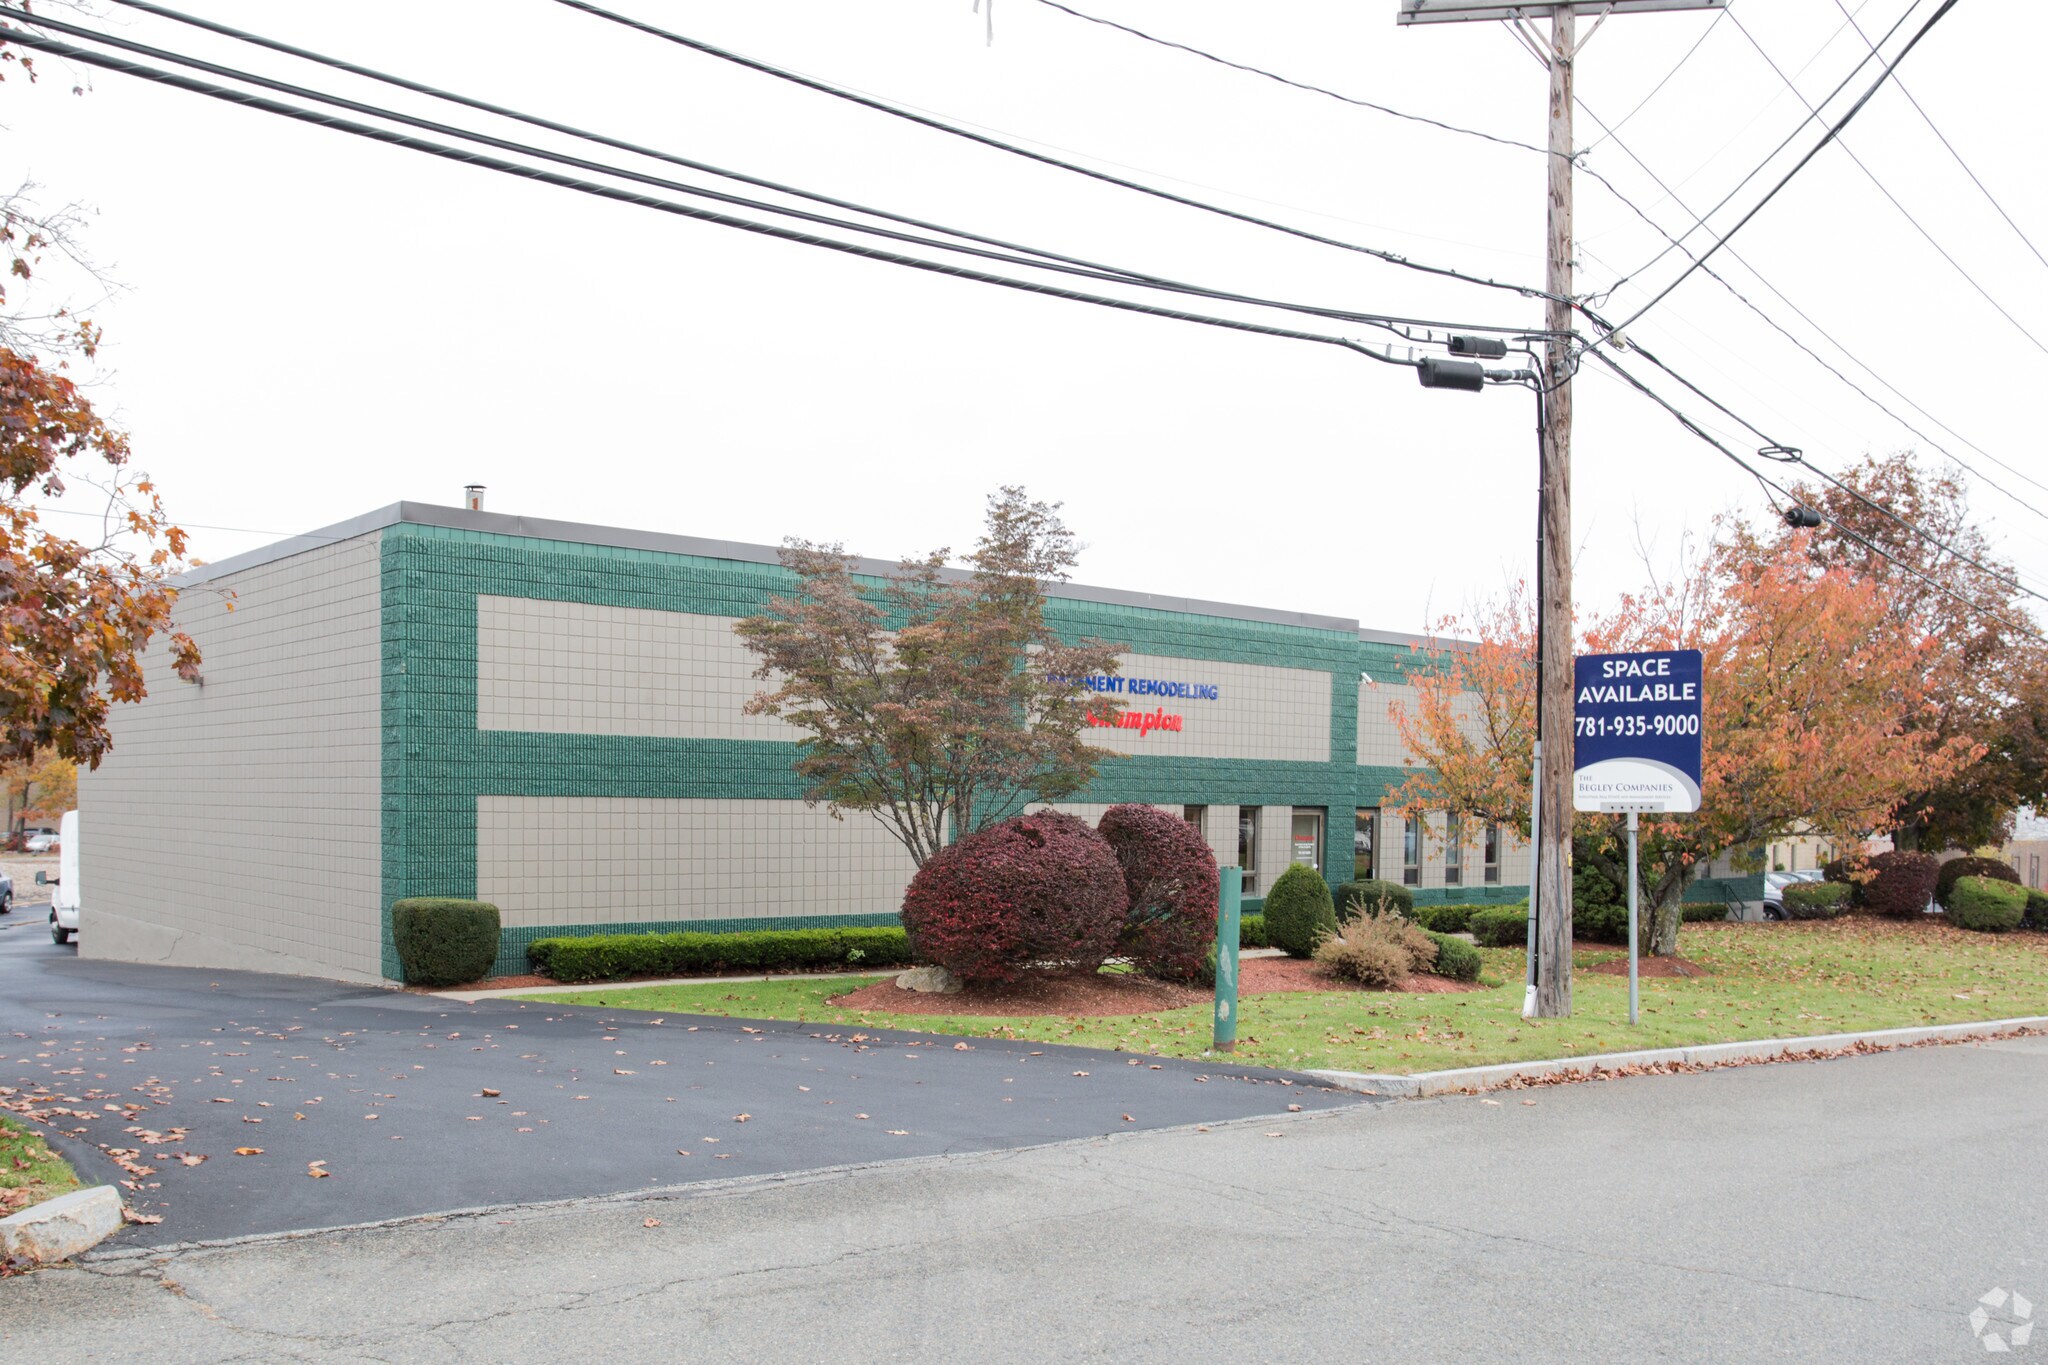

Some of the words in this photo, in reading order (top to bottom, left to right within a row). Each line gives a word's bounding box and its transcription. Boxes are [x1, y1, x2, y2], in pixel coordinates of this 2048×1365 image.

[1602, 658, 1671, 679] SPACE
[1128, 677, 1218, 700] REMODELING
[1577, 682, 1696, 703] AVAILABLE
[1575, 714, 1699, 737] 781-935-9000
[1579, 783, 1614, 792] BEGLEY
[1615, 782, 1673, 792] COMPANIES
